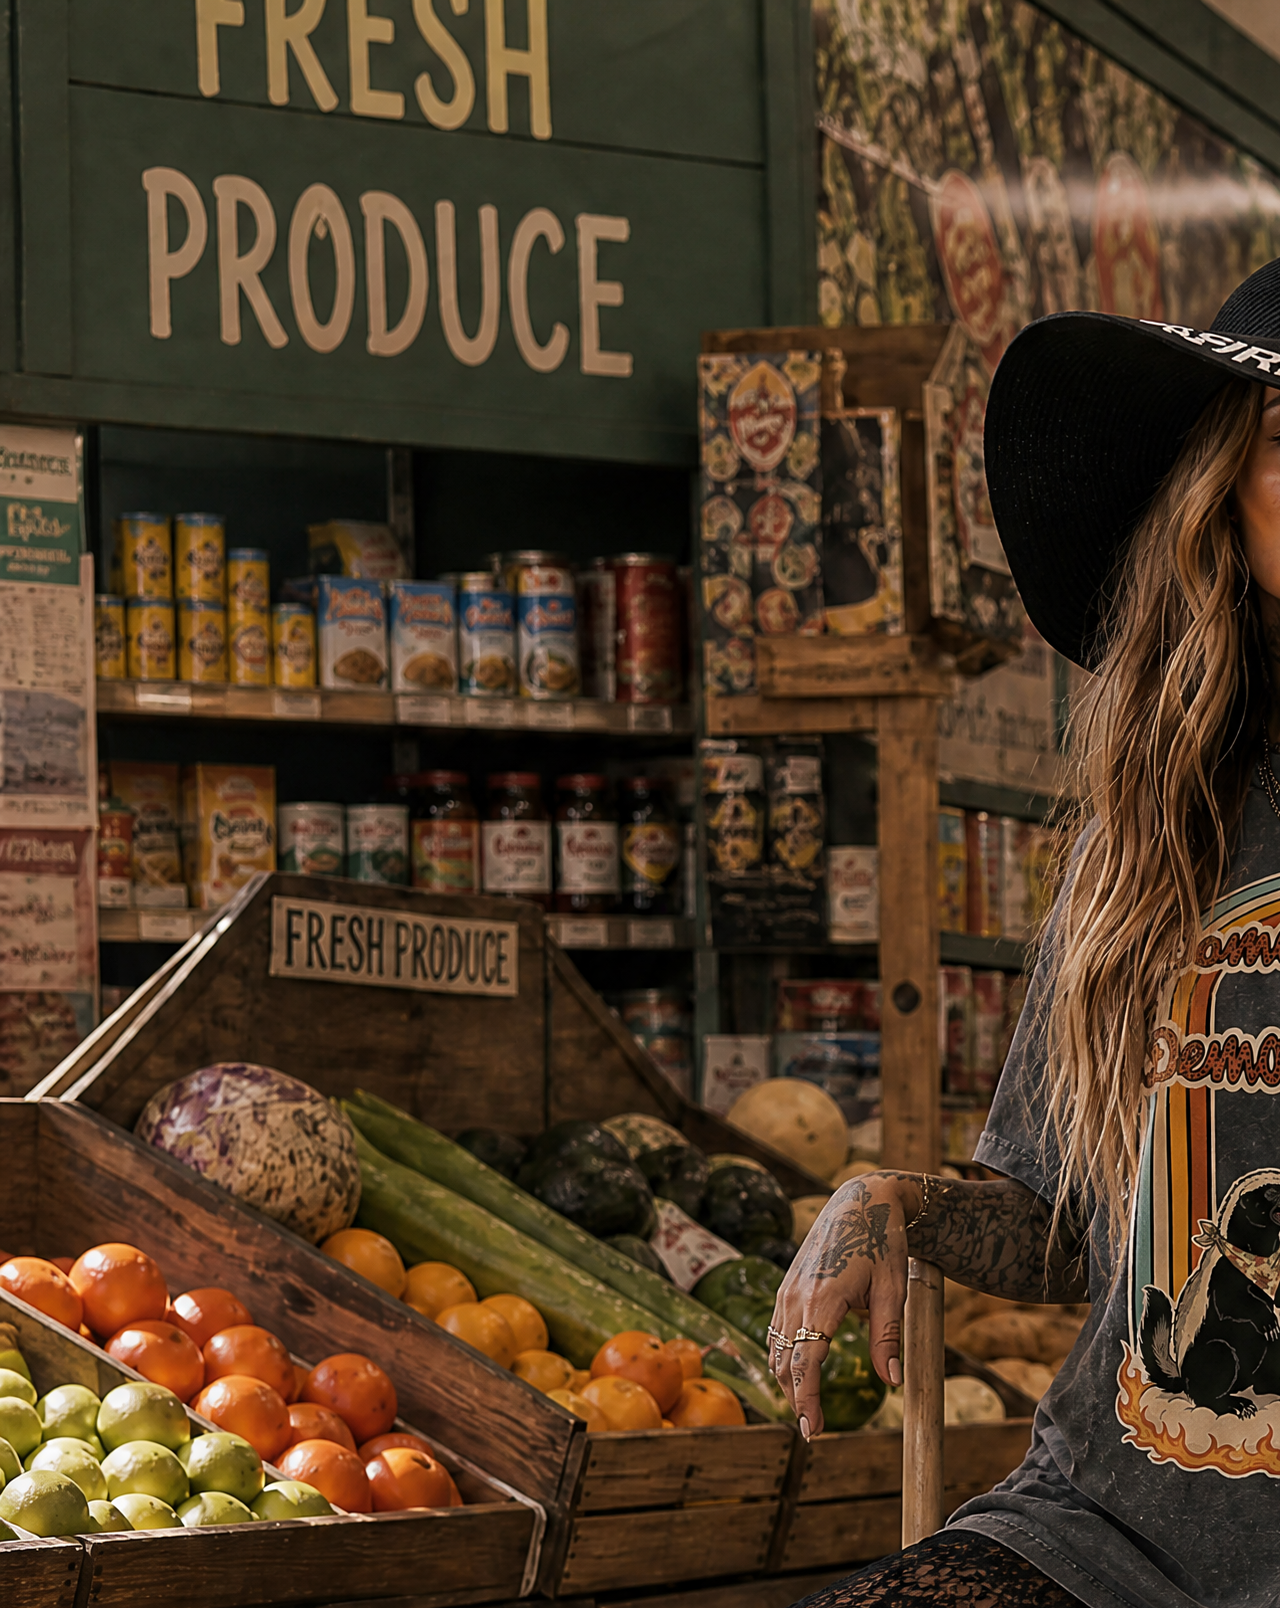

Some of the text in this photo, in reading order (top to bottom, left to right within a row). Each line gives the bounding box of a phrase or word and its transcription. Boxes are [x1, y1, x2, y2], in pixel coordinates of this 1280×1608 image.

[195, 0, 554, 140] FRESH
[142, 166, 633, 377] PRODUCE
[284, 907, 510, 985] FRESH PRODUCE
